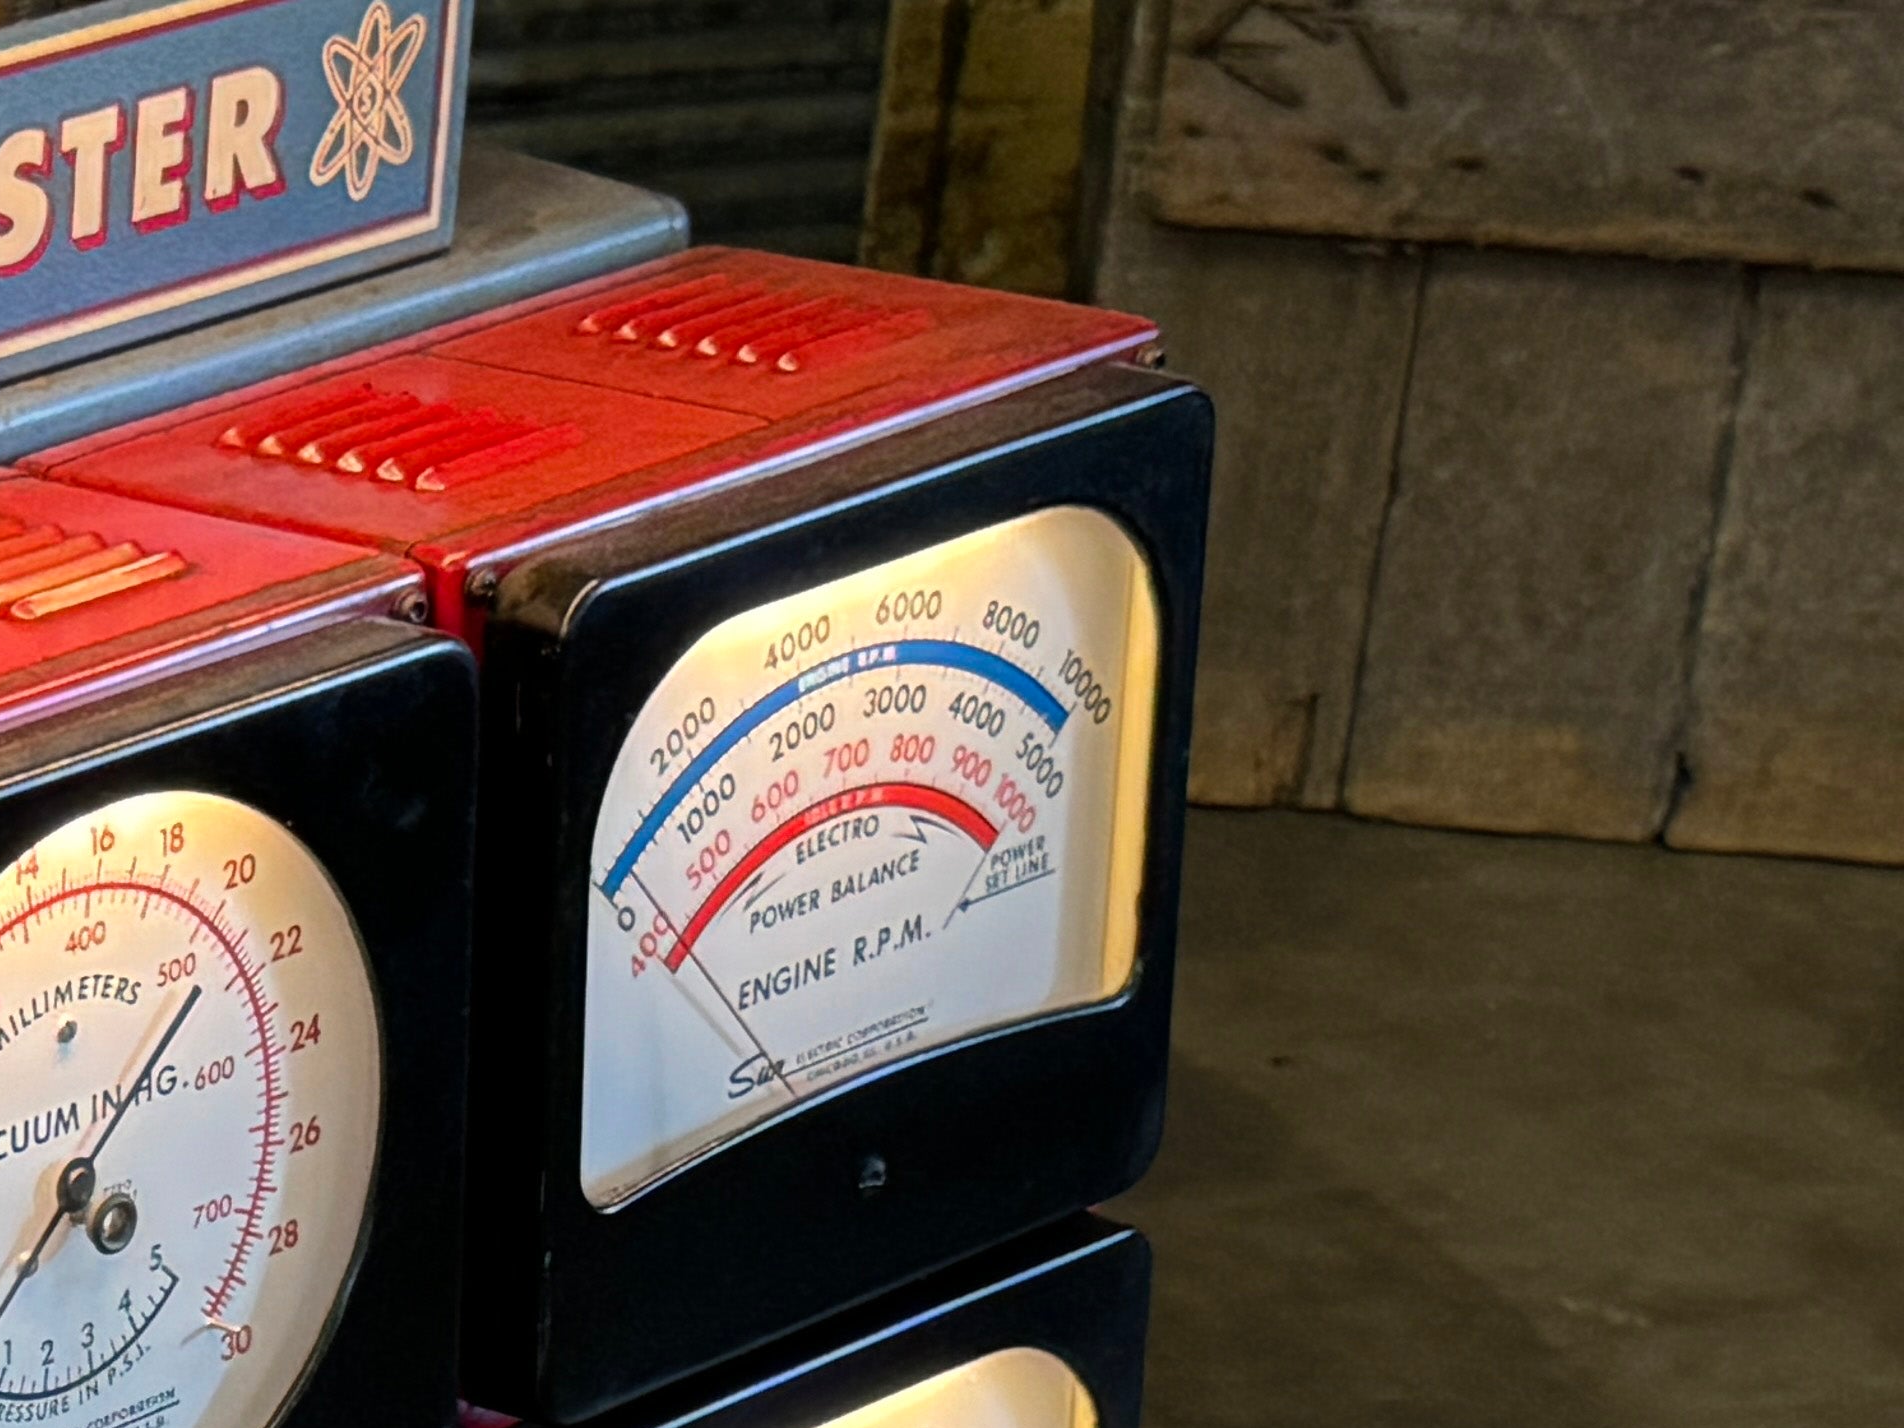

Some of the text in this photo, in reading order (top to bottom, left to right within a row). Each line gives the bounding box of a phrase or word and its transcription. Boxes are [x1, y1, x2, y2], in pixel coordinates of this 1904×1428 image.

[650, 697, 715, 776] 2000
[763, 614, 830, 670] 4000
[875, 590, 942, 626] 6000
[982, 600, 1040, 649] 8000
[1057, 649, 1111, 725] 10000
[677, 773, 736, 844] 1000
[768, 703, 835, 762] 2000
[862, 683, 926, 718] 3000
[949, 692, 1005, 737] 4000
[1016, 732, 1064, 799] 5000
[749, 849, 920, 935] POWER BALANCE
[795, 815, 879, 865] ELECTRO
[64, 921, 106, 955] 400
[156, 952, 196, 988] 500
[194, 1055, 234, 1091] 600
[91, 822, 321, 1256] 16 18 20 22 24 26 28
[738, 914, 931, 1011] ENGINE R.P.M.
